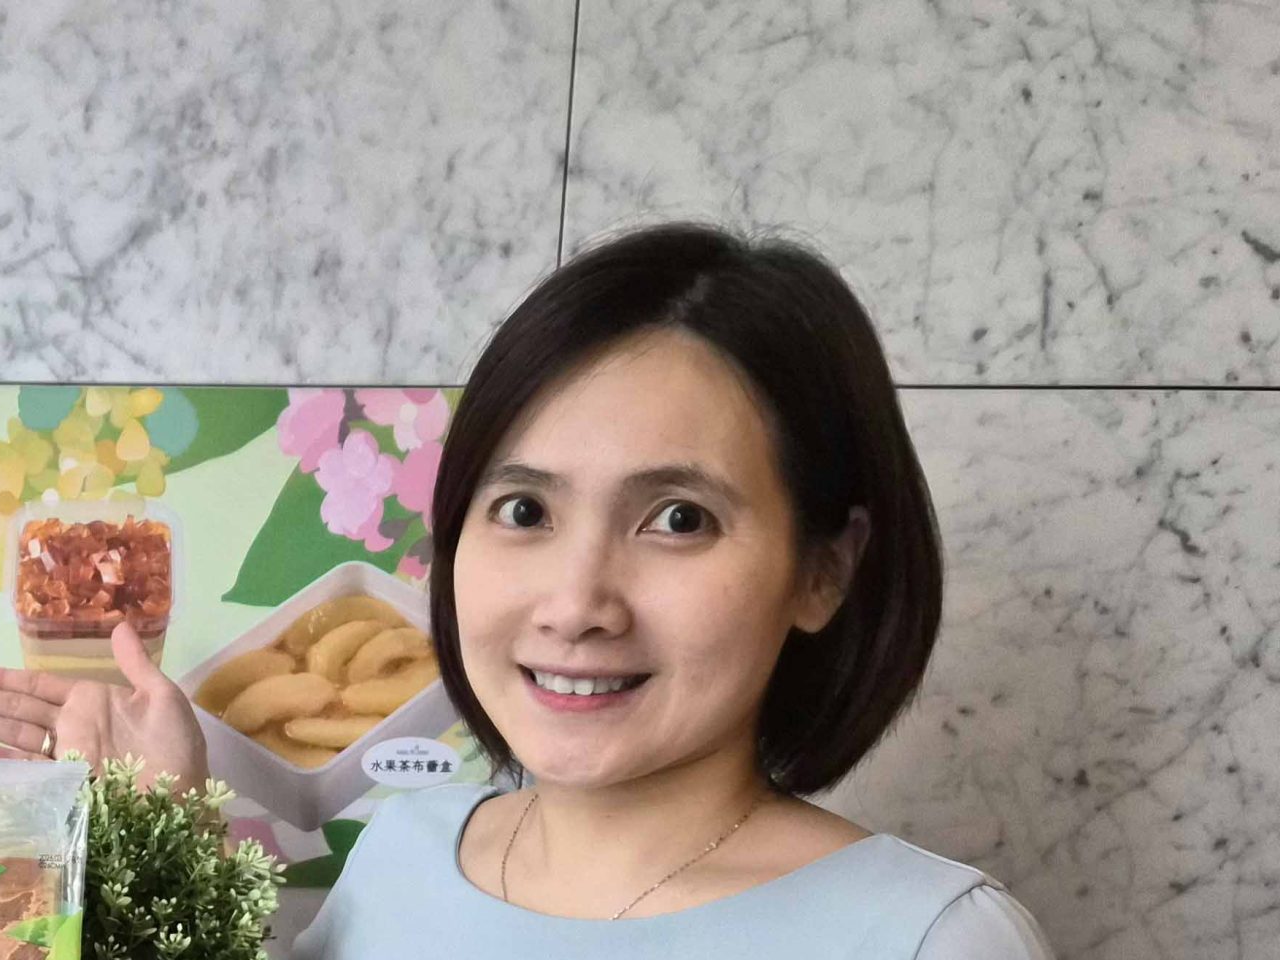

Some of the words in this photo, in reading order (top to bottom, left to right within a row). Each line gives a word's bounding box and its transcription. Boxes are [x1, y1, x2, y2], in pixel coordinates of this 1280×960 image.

[371, 759, 453, 773] 水果茶布蕾盒
